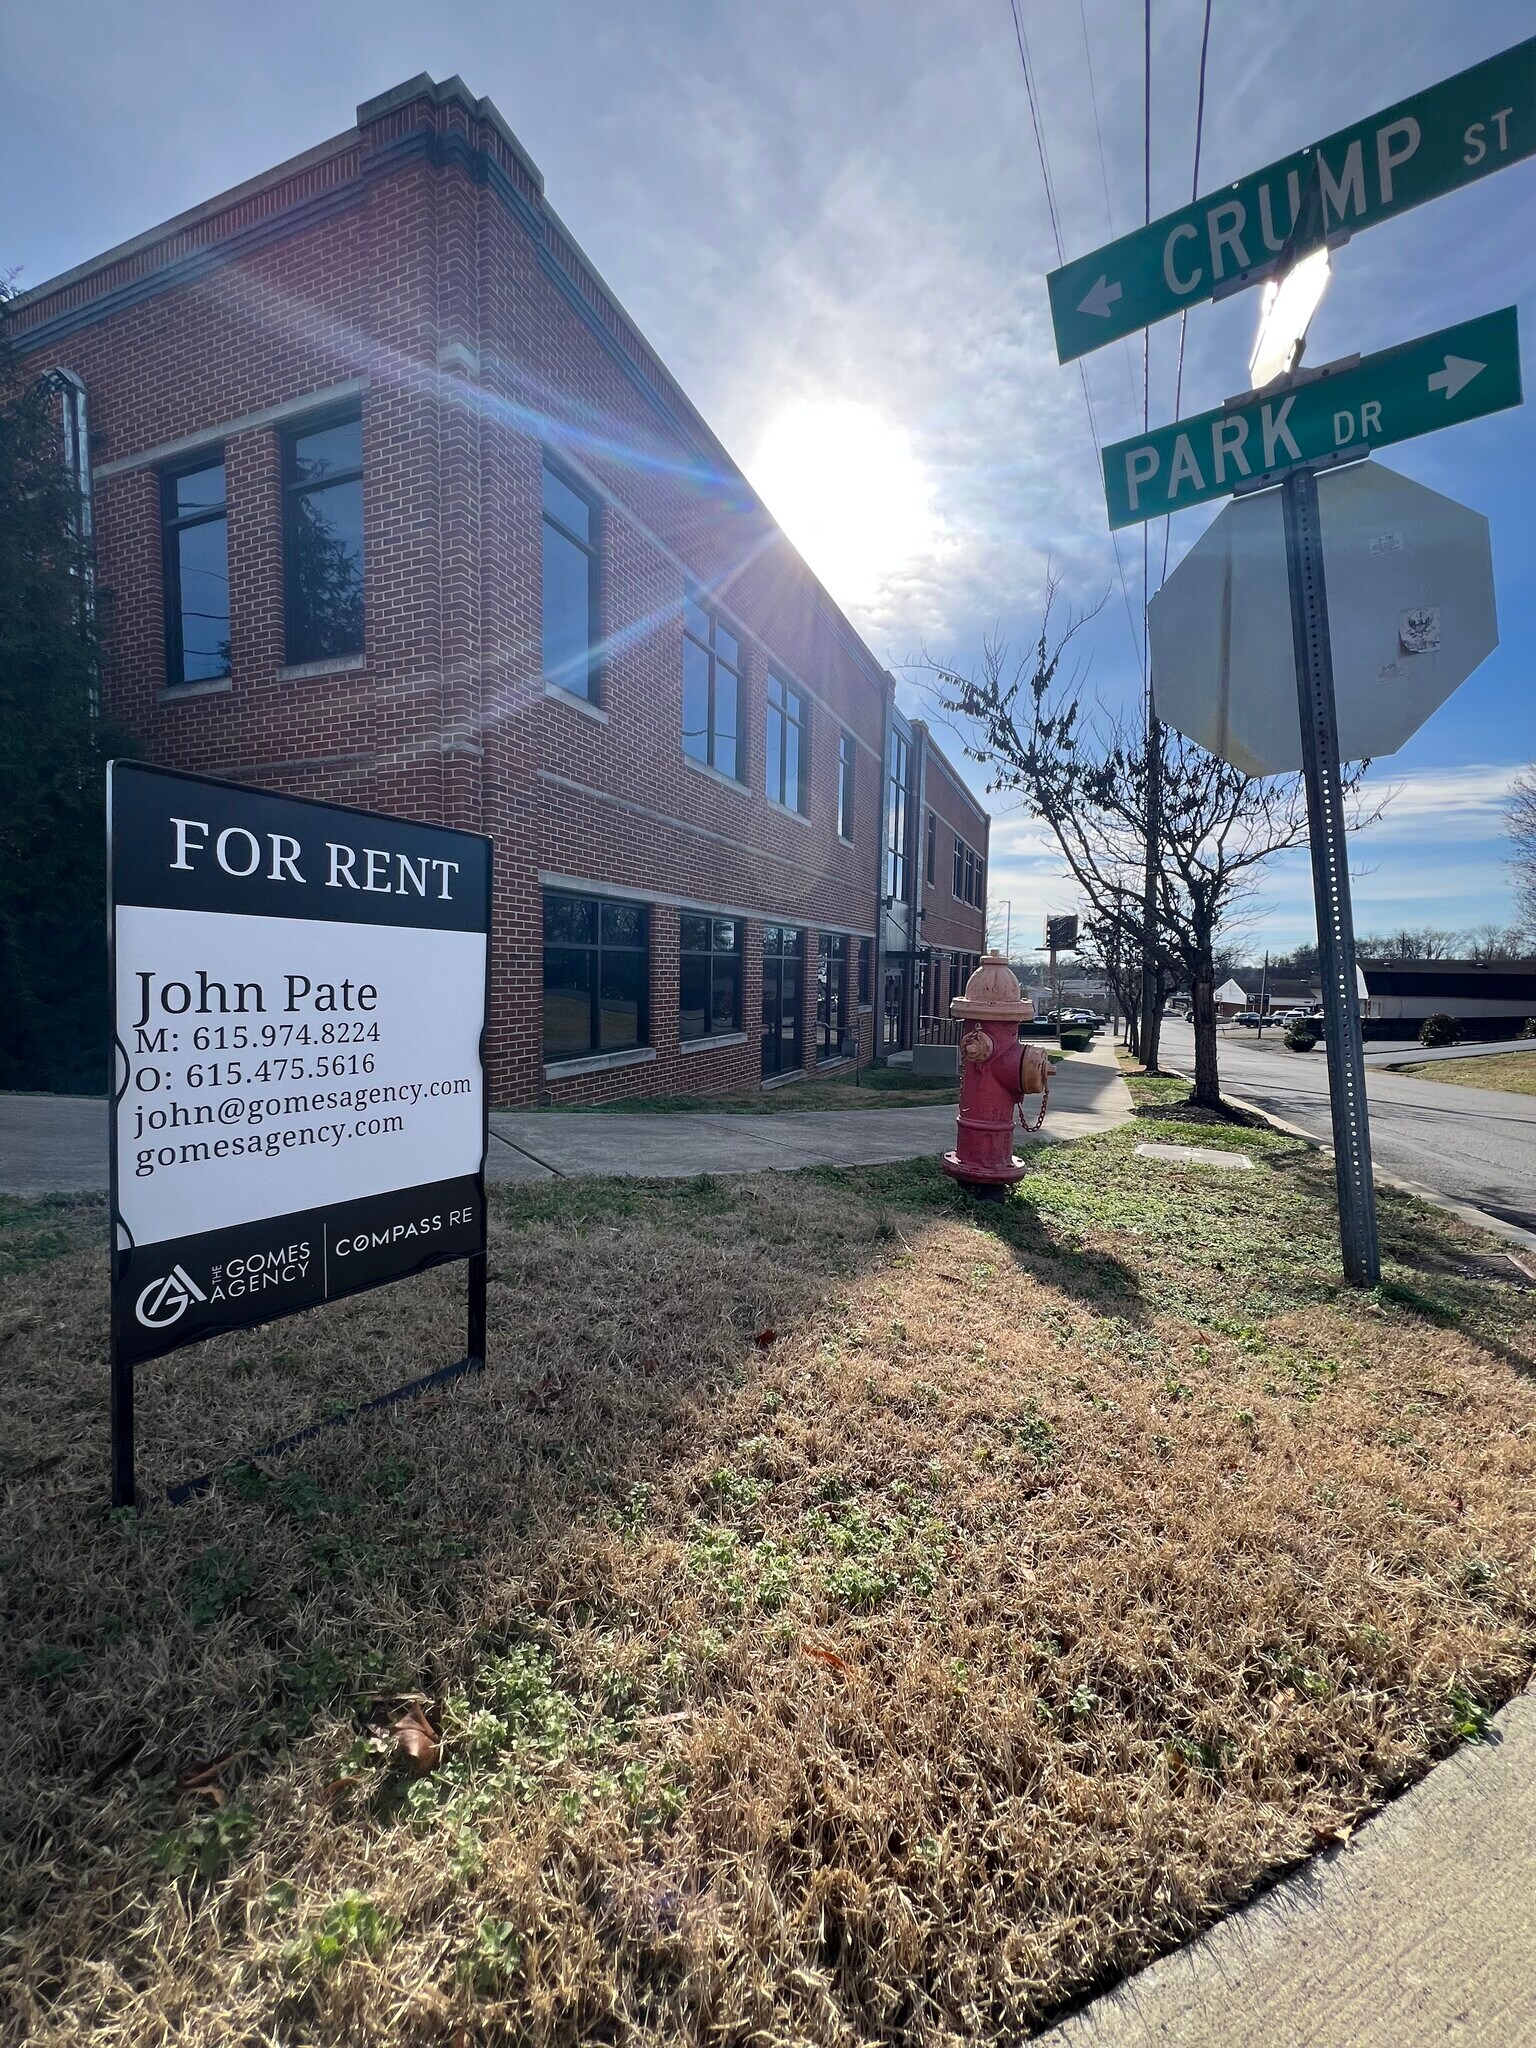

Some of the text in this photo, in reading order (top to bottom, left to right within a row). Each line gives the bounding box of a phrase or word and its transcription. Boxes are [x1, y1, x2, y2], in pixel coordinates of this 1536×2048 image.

[1163, 106, 1514, 295] CRUMP ST
[1125, 395, 1383, 511] PARK DR
[169, 817, 460, 901] FOR RENT
[132, 971, 379, 1028] John Pate
[134, 1021, 382, 1054] M: 615.974.8224
[135, 1052, 376, 1093] O: 615.475.5616
[133, 1075, 473, 1140] john@gomesagency.com
[134, 1114, 405, 1178] gomesagency.com
[335, 1206, 473, 1257] COMPASS RE
[209, 1260, 310, 1304] AGENCY
[211, 1264, 223, 1286] THE
[226, 1242, 311, 1278] GOMES
